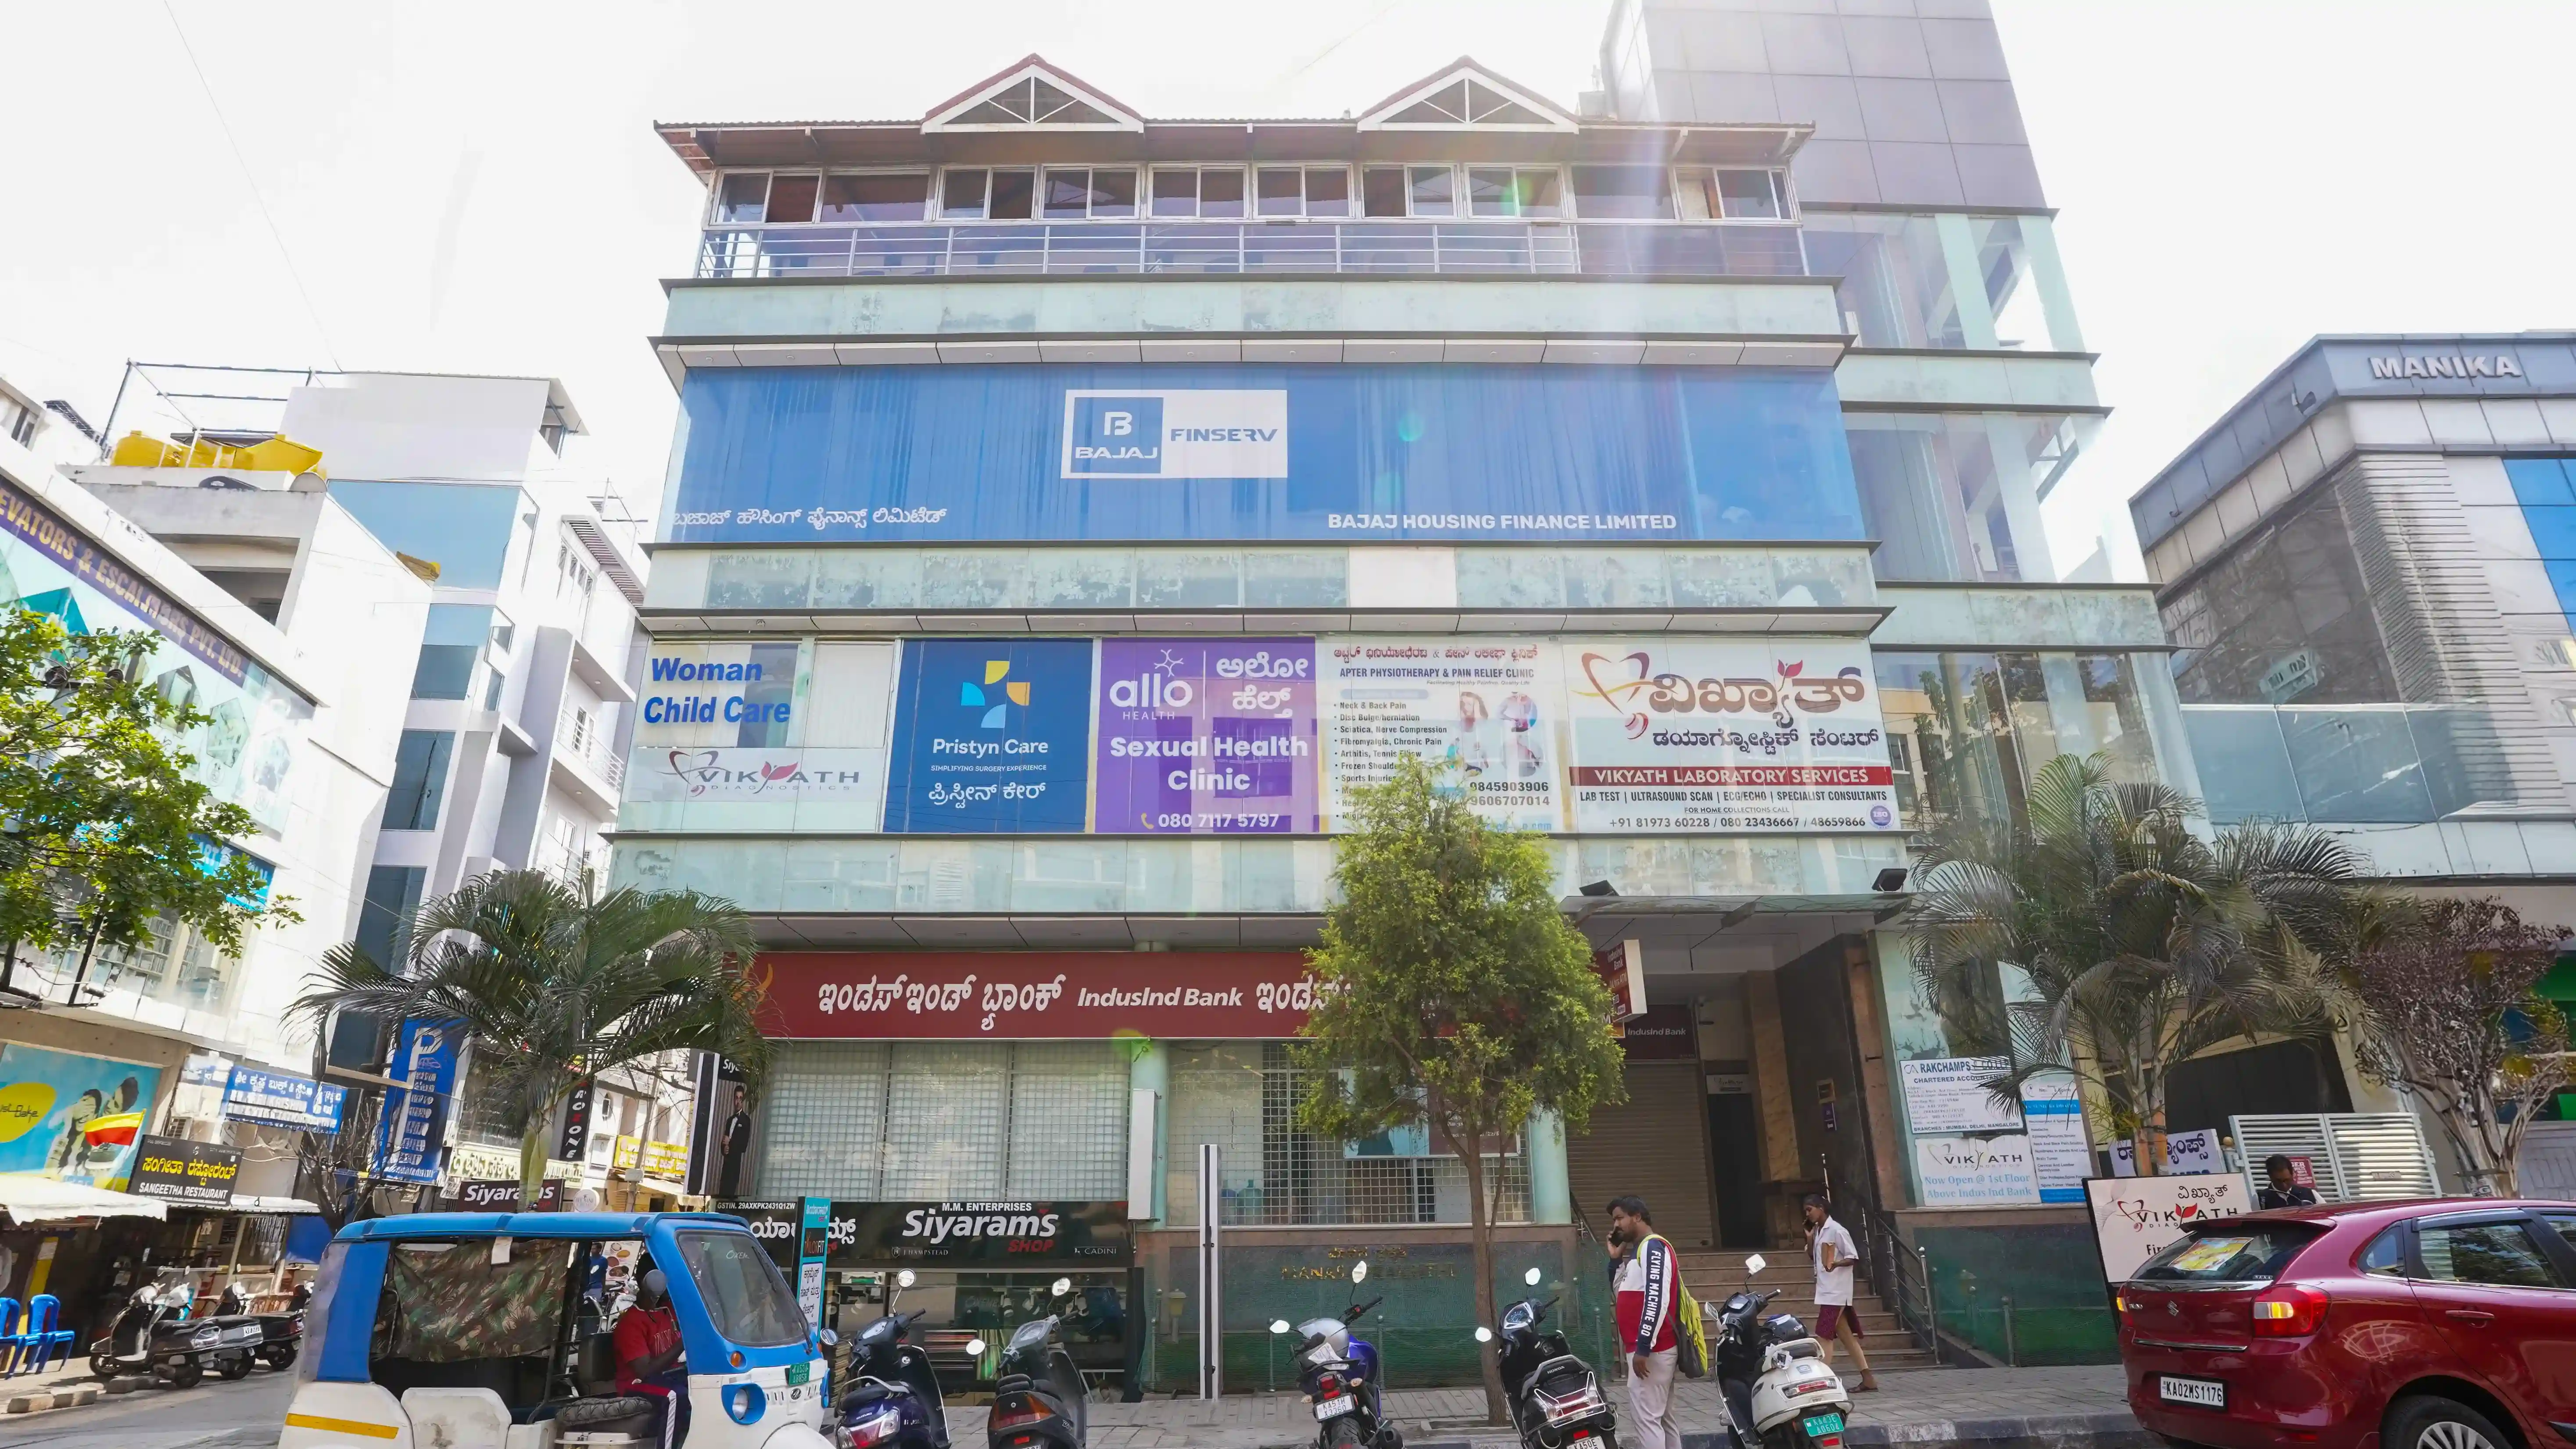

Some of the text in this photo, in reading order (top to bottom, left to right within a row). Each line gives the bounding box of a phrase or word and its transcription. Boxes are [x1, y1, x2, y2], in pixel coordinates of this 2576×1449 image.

[2368, 356, 2522, 379] MANIKA
[1171, 427, 1278, 442] FINSERV
[1075, 446, 1158, 459] BAJAJ
[1327, 514, 1677, 530] BAJAJ HOUSING FINANCE LIMITED
[1433, 650, 1440, 658] &
[652, 657, 763, 682] Woman
[1340, 668, 1534, 678] APTER PHYSIOTHERAPY & PAIN RELIEF CLINIC
[1109, 673, 1193, 708] allo
[644, 696, 791, 723] Child Care
[1123, 711, 1175, 720] HEALTH
[1358, 714, 1420, 722] Bulge/herniation
[1400, 726, 1447, 735] Compression
[933, 738, 1048, 759] Pristyn Care
[1110, 736, 1308, 757] Sexual Health
[1340, 738, 1391, 747] Fibromyalgia,
[697, 765, 859, 789] VIKYATH
[1168, 768, 1250, 791] Clinic
[1594, 769, 1868, 784] VIKYATH LABORATORY SERVICES
[1470, 782, 1549, 791] 9845903906
[1470, 796, 1550, 805] 9606707014
[1580, 791, 1887, 801] LAB TEST ULTRASOUND SCAN ECG/ECHO SPECIALIST CONSULTANTS
[1158, 813, 1279, 827] 080 7117 5797
[1609, 817, 1866, 828] +91 81973 60228 080 23436667 48659866
[1078, 987, 1181, 1007] IndusInd
[1184, 987, 1243, 1006] Bank
[1920, 1061, 1971, 1073] RAKCHAMPS
[1944, 1152, 2022, 1169] VIKYATH
[1925, 1174, 2030, 1185] Now Open @ 1st Floor
[139, 1182, 228, 1199] SANGEETHA RESTAURANT
[1927, 1187, 2032, 1198] Above Indus Ind Bank
[942, 1202, 1032, 1212] M.M. ENTERPRISES
[2137, 1203, 2238, 1227] VIKYATH
[1008, 1239, 1054, 1252] SHOP
[1641, 1250, 1661, 1337] FLYING MACHINE 80
[1547, 1365, 1565, 1374] HONDA
[2166, 1381, 2222, 1402] KA02MS1176
[1574, 1438, 1597, 1449] KA50E
